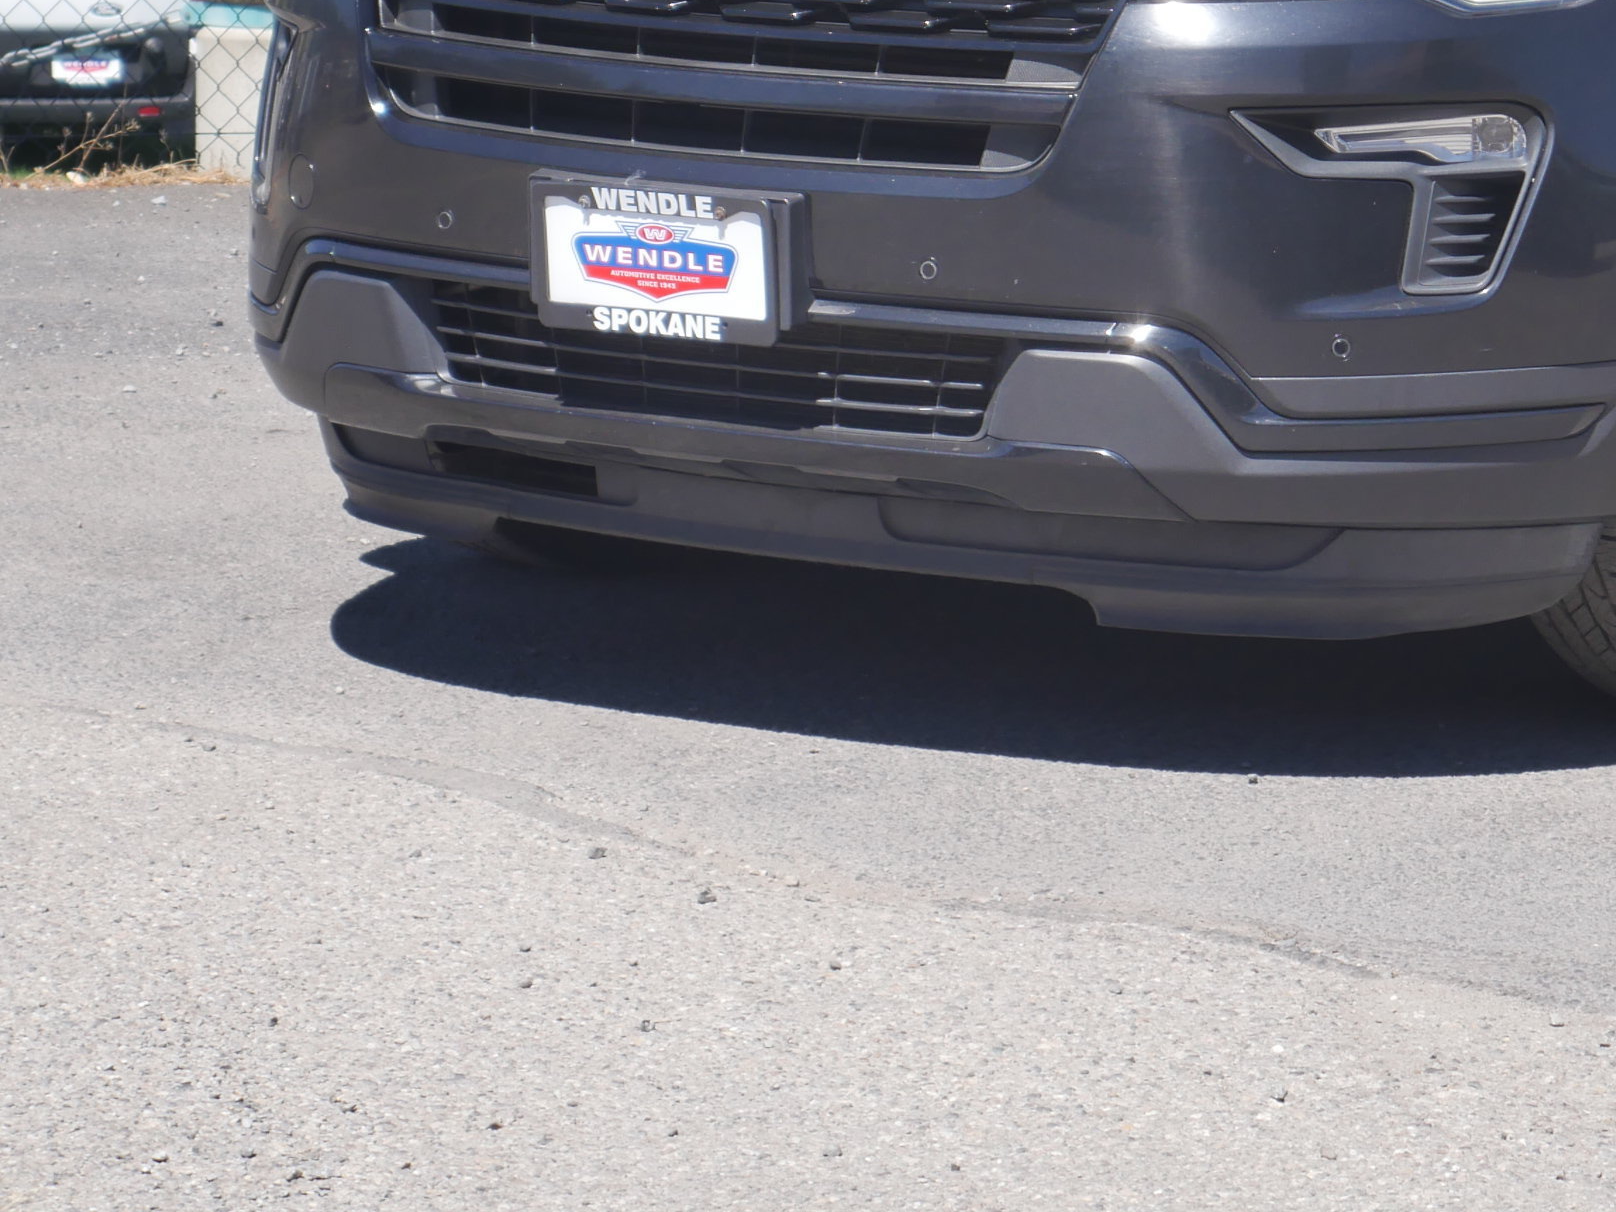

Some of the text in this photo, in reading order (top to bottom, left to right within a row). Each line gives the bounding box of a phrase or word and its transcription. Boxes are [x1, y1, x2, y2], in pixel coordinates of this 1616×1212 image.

[590, 186, 715, 219] WENDLE
[583, 243, 724, 273] WENDLE
[610, 269, 701, 284] AUTOMOTIVE EXCELLENCE
[637, 279, 658, 288] SINCE
[592, 306, 722, 340] SPOKANE
